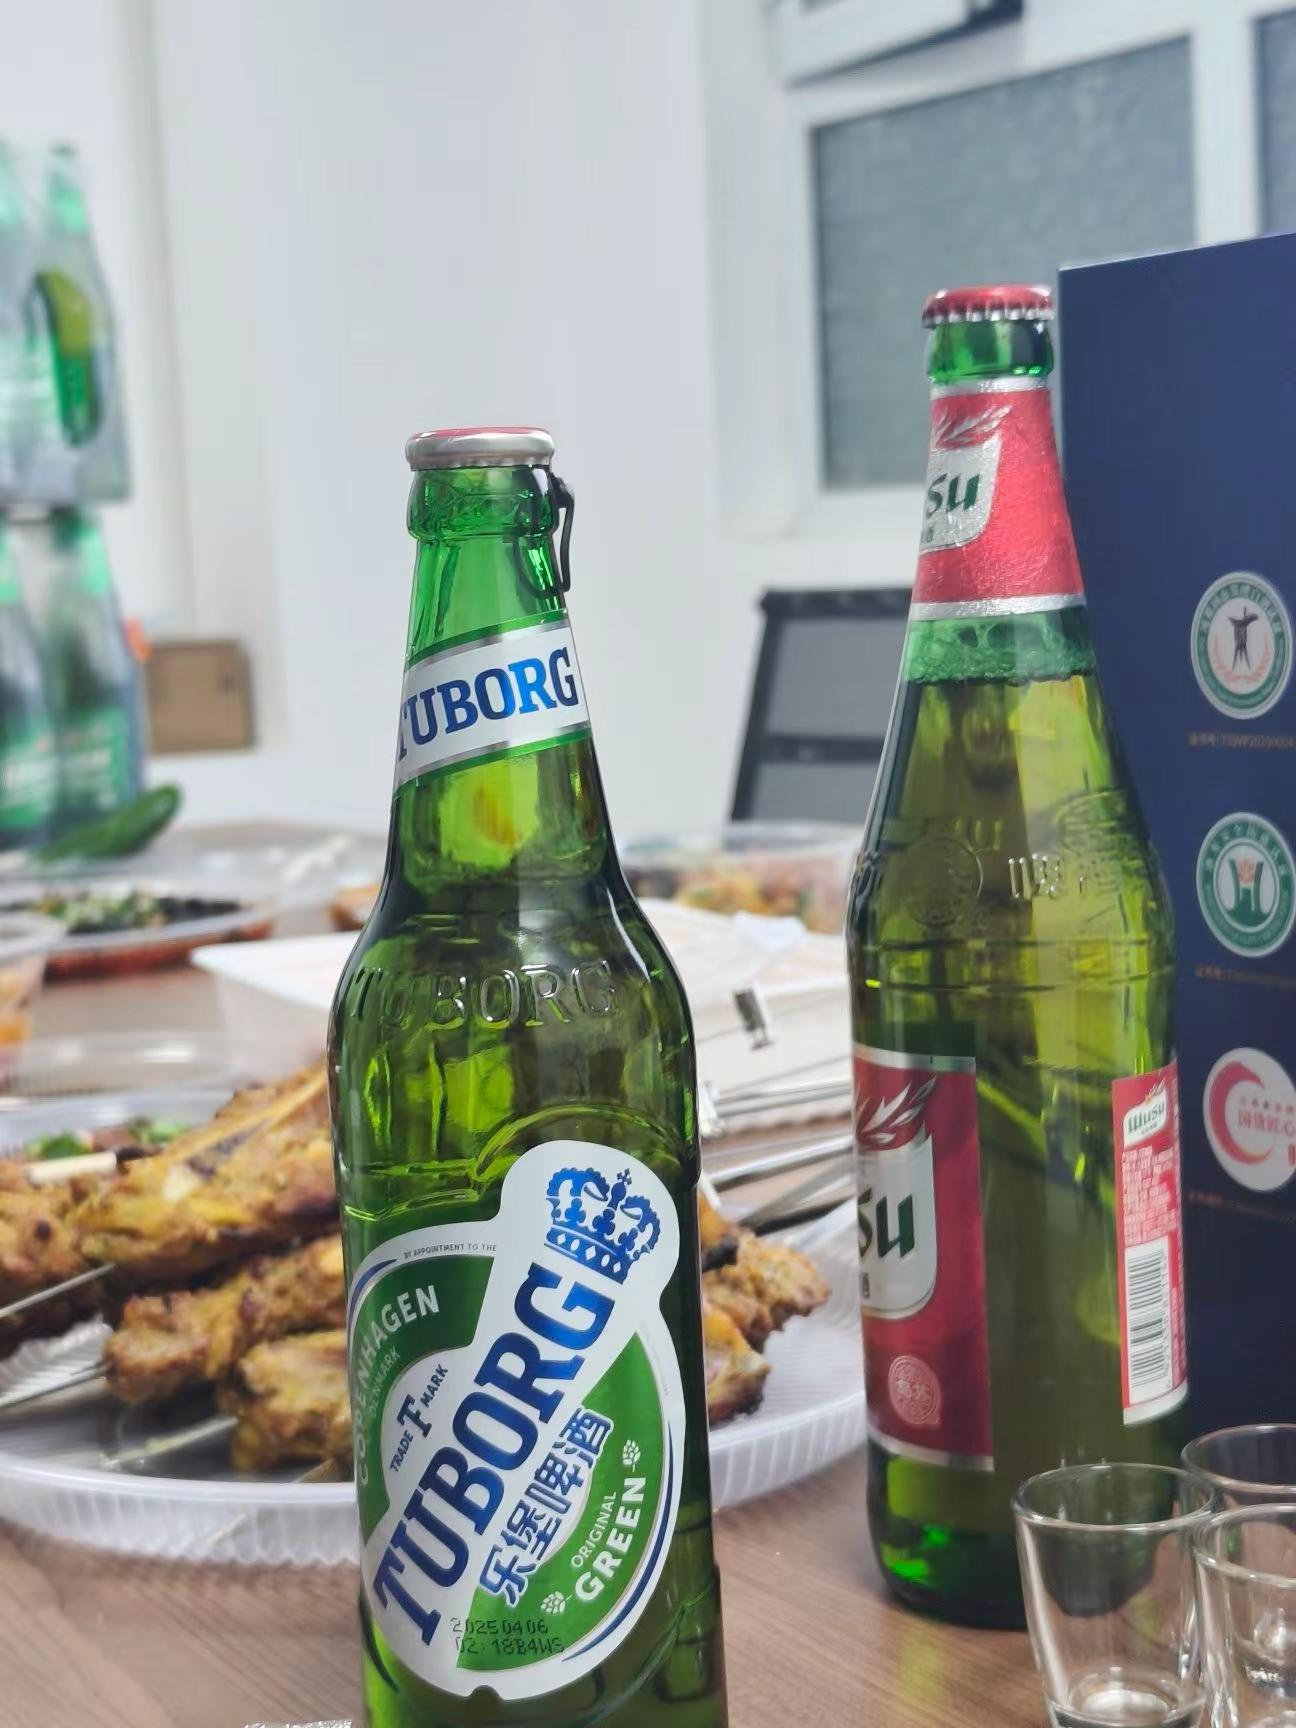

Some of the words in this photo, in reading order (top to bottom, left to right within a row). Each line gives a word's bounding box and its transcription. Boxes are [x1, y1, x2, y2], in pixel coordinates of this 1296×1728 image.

[404, 1251, 413, 1259] BY
[413, 1243, 465, 1257] APPOINTMENT
[468, 1243, 479, 1251] TO
[482, 1243, 497, 1252] THE
[368, 1345, 401, 1419] DENMARK
[389, 1429, 414, 1473] TRADE
[420, 1363, 448, 1408] MARK
[373, 1261, 616, 1647] TUBORG
[479, 1407, 613, 1606] 乐堡啤酒
[570, 1491, 617, 1568] ORIGINAL
[575, 1476, 647, 1602] GREEN
[450, 1616, 549, 1635] 20250406
